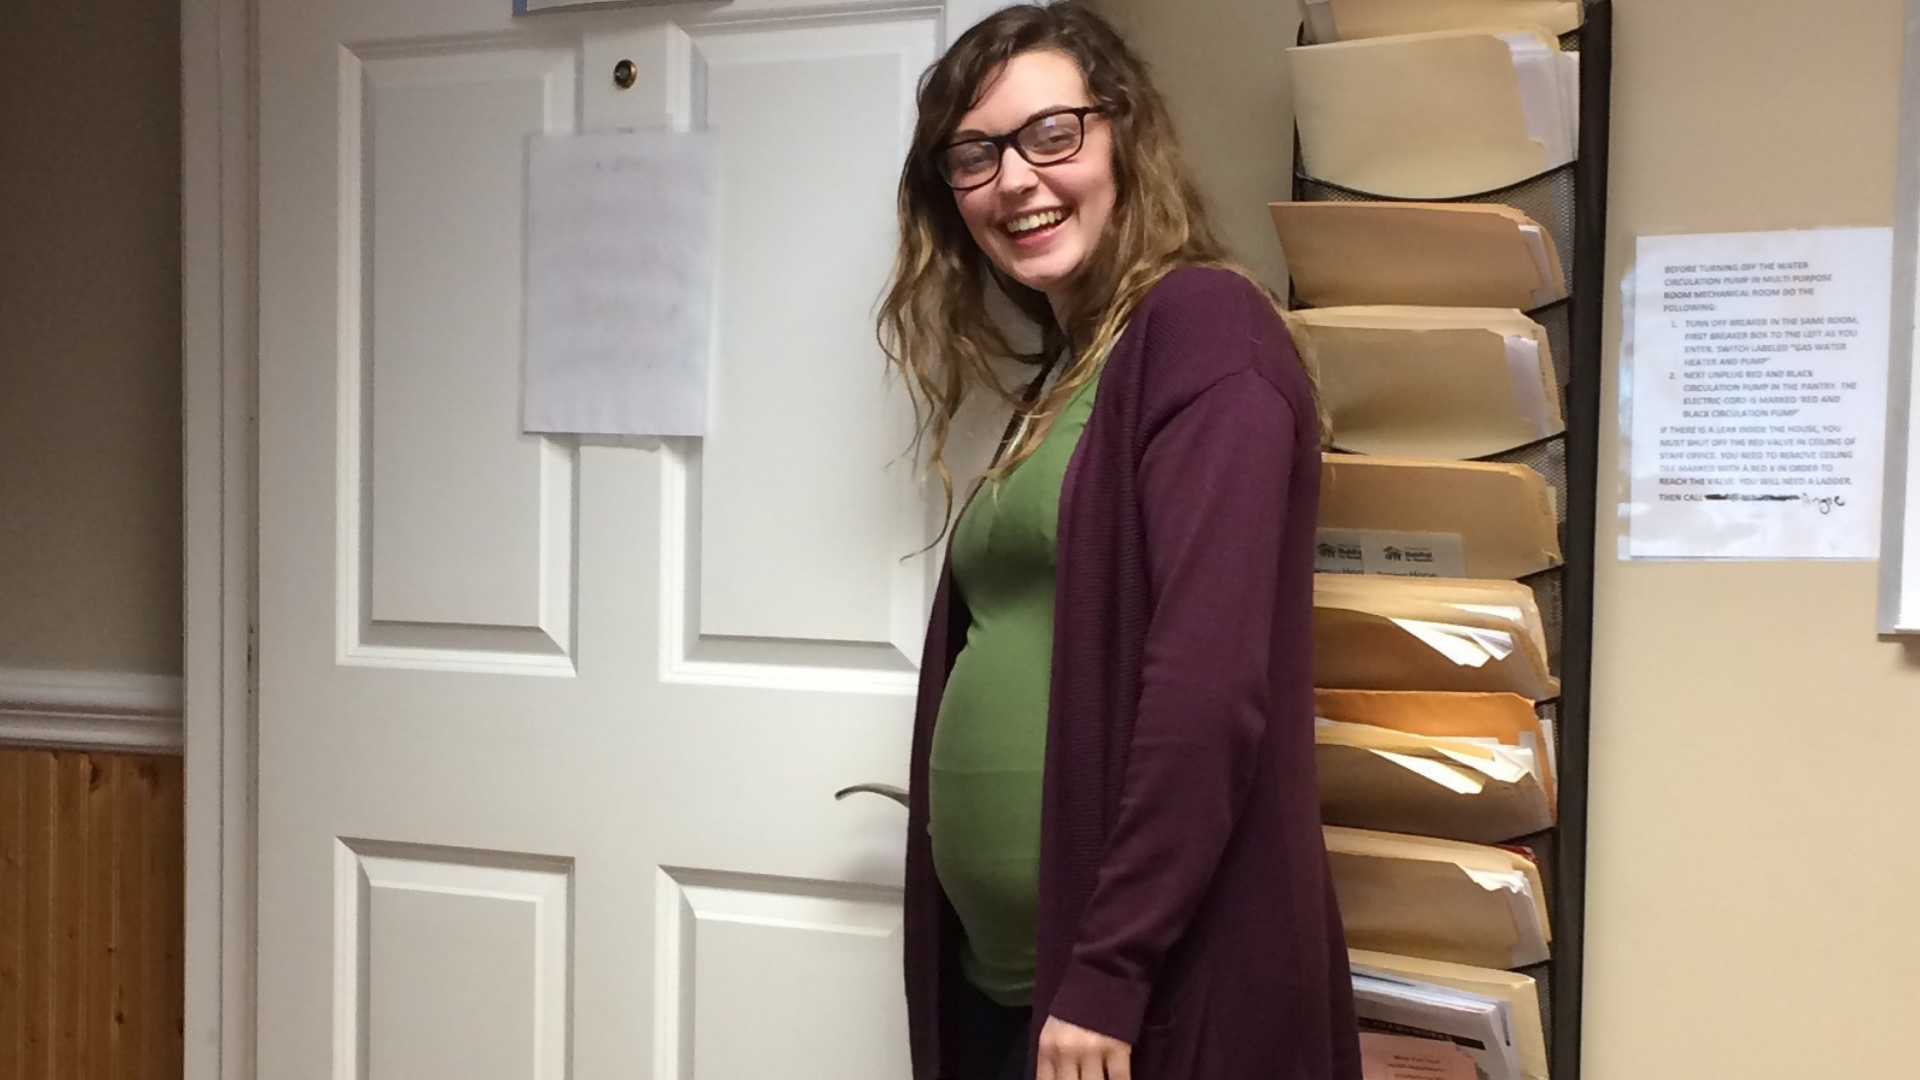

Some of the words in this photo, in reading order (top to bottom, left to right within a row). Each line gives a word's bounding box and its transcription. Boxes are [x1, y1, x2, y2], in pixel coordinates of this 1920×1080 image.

[1665, 265, 1697, 274] BEFORE
[1700, 264, 1739, 273] TURNING
[1741, 262, 1757, 272] OFF
[1759, 262, 1775, 271] THE
[1777, 261, 1809, 270] WATER
[1664, 277, 1721, 287] CIRCULATION
[1723, 276, 1749, 285] PUMP
[1751, 275, 1760, 284] IN
[1762, 275, 1791, 284] MULTI
[1792, 274, 1832, 283] PURPOSE
[1663, 291, 1692, 300] ROOM
[1694, 290, 1749, 298] MECHANICAL
[1752, 288, 1780, 297] ROOM
[1782, 287, 1796, 297] DO
[1799, 287, 1815, 296] THE
[1685, 319, 1709, 328] TURN
[1711, 318, 1727, 328] OFF
[1729, 318, 1768, 327] BREAKER
[1770, 317, 1780, 326] IN
[1781, 317, 1798, 326] THE
[1799, 316, 1825, 326] SAME
[1684, 332, 1707, 341] FIRST
[1709, 331, 1748, 340] BREAKER
[1770, 330, 1782, 339] TO
[1784, 330, 1800, 339] THE
[1803, 329, 1823, 339] LEFT
[1824, 329, 1836, 338] AS
[1838, 328, 1857, 338] YOU
[1716, 344, 1750, 353] SWITCH
[1751, 344, 1789, 353] LABELED
[1814, 342, 1847, 351] WATER
[1684, 358, 1717, 367] HEATER
[1719, 357, 1739, 366] AND
[1684, 370, 1705, 380] NEXT
[1708, 370, 1744, 379] UNPLUG
[1745, 370, 1763, 379] RED
[1765, 370, 1784, 379] AND
[1786, 369, 1813, 378] BLACK
[1683, 383, 1740, 392] CIRCULATION
[1742, 383, 1768, 392] PUMP
[1770, 383, 1780, 391] IN
[1782, 382, 1799, 391] THE
[1840, 381, 1857, 391] THE
[1683, 396, 1721, 406] ELECTRIC
[1722, 396, 1747, 405] CORD
[1750, 396, 1757, 405] IS
[1759, 395, 1797, 404] MARKED
[1821, 395, 1841, 404] AND
[1683, 409, 1710, 419] BLACK
[1711, 409, 1768, 418] CIRCULATION
[1669, 425, 1697, 434] THERE
[1698, 425, 1706, 435] IS
[1708, 425, 1715, 434] A
[1716, 425, 1737, 434] LEAK
[1739, 425, 1767, 434] INSIDE
[1769, 425, 1785, 434] THE
[1822, 424, 1841, 433] YOU
[1660, 438, 1685, 448] MUST
[1687, 438, 1710, 447] SHUT
[1711, 438, 1727, 447] OFF
[1729, 438, 1746, 447] THE
[1748, 438, 1765, 447] RED
[1767, 438, 1794, 447] VALVE
[1796, 438, 1806, 446] IN
[1808, 437, 1842, 447] CEILING
[1844, 437, 1856, 446] OF
[1659, 451, 1685, 460] STAFF
[1720, 451, 1739, 460] YOU
[1741, 451, 1764, 460] NEED
[1766, 450, 1778, 460] TO
[1779, 451, 1816, 460] REMOVE
[1819, 450, 1853, 460] CEILING
[1678, 464, 1716, 473] MARKED
[1717, 464, 1740, 473] WITH
[1742, 464, 1749, 473] A
[1750, 464, 1768, 473] RED
[1777, 464, 1787, 473] IN
[1789, 463, 1819, 473] ORDER
[1821, 463, 1833, 473] TO
[1659, 477, 1687, 486] REACH
[1689, 477, 1705, 486] THE
[1739, 477, 1758, 486] YOU
[1760, 477, 1780, 486] WILL
[1782, 477, 1805, 486] NEED
[1808, 477, 1814, 486] A
[1659, 493, 1682, 502] THEN
[1684, 493, 1703, 502] CALL
